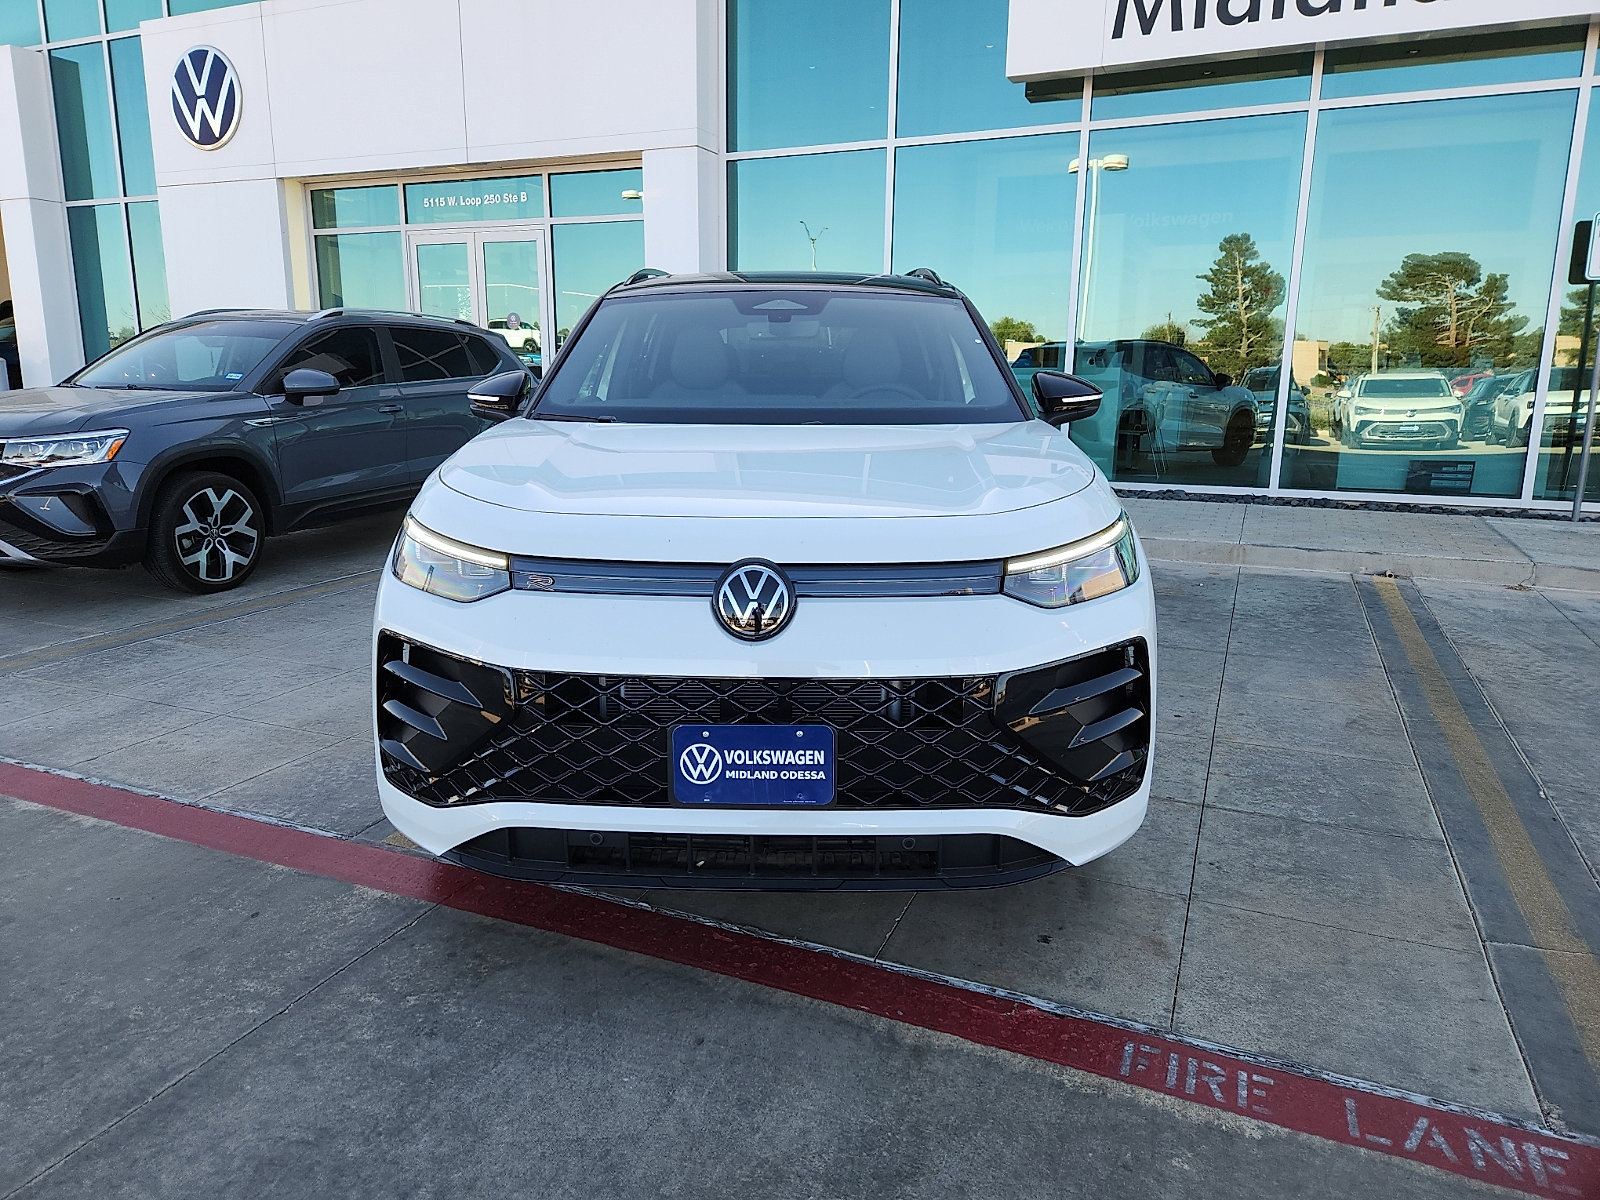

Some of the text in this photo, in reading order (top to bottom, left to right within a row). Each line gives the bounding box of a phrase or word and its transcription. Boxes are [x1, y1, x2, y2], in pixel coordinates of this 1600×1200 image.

[423, 191, 528, 208] 5115 W. Loop 250 Ste B
[724, 749, 825, 765] VOLKSWAGEN
[725, 770, 826, 780] MIDLAND ODESSA
[1119, 1041, 1583, 1196] FIRE LANE
